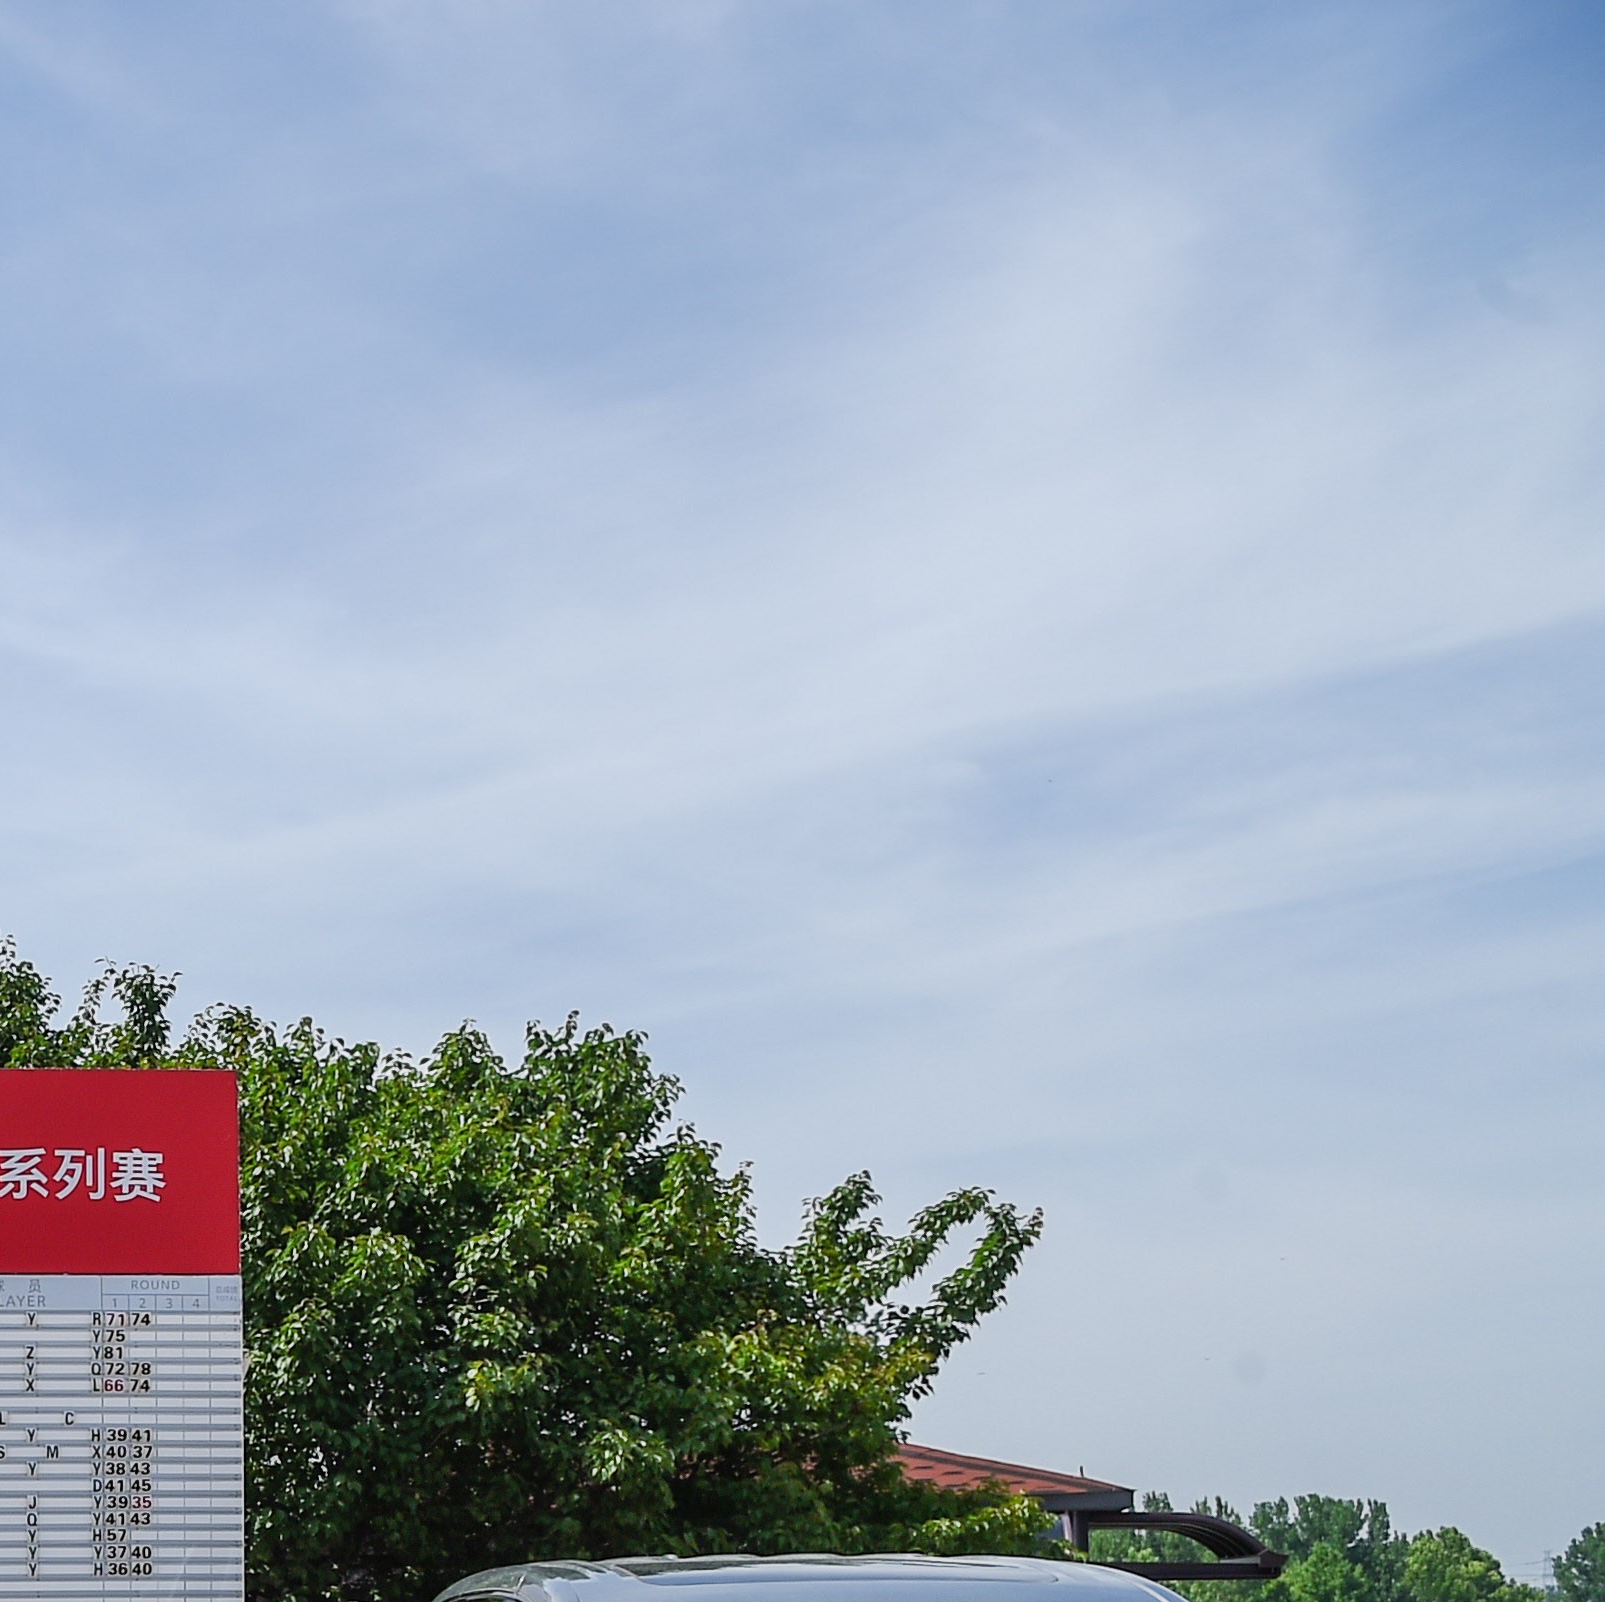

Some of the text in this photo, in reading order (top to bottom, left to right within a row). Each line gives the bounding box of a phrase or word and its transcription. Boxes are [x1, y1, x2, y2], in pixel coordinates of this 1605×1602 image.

[131, 1279, 180, 1290] ROUND
[25, 1380, 35, 1392] X
[93, 1380, 100, 1392] L
[104, 1380, 124, 1392] 66
[130, 1380, 150, 1392] 74
[64, 1412, 74, 1426] C
[28, 1497, 37, 1509] J
[93, 1497, 102, 1509] Y
[107, 1497, 128, 1509] 39
[132, 1497, 152, 1509] 35
